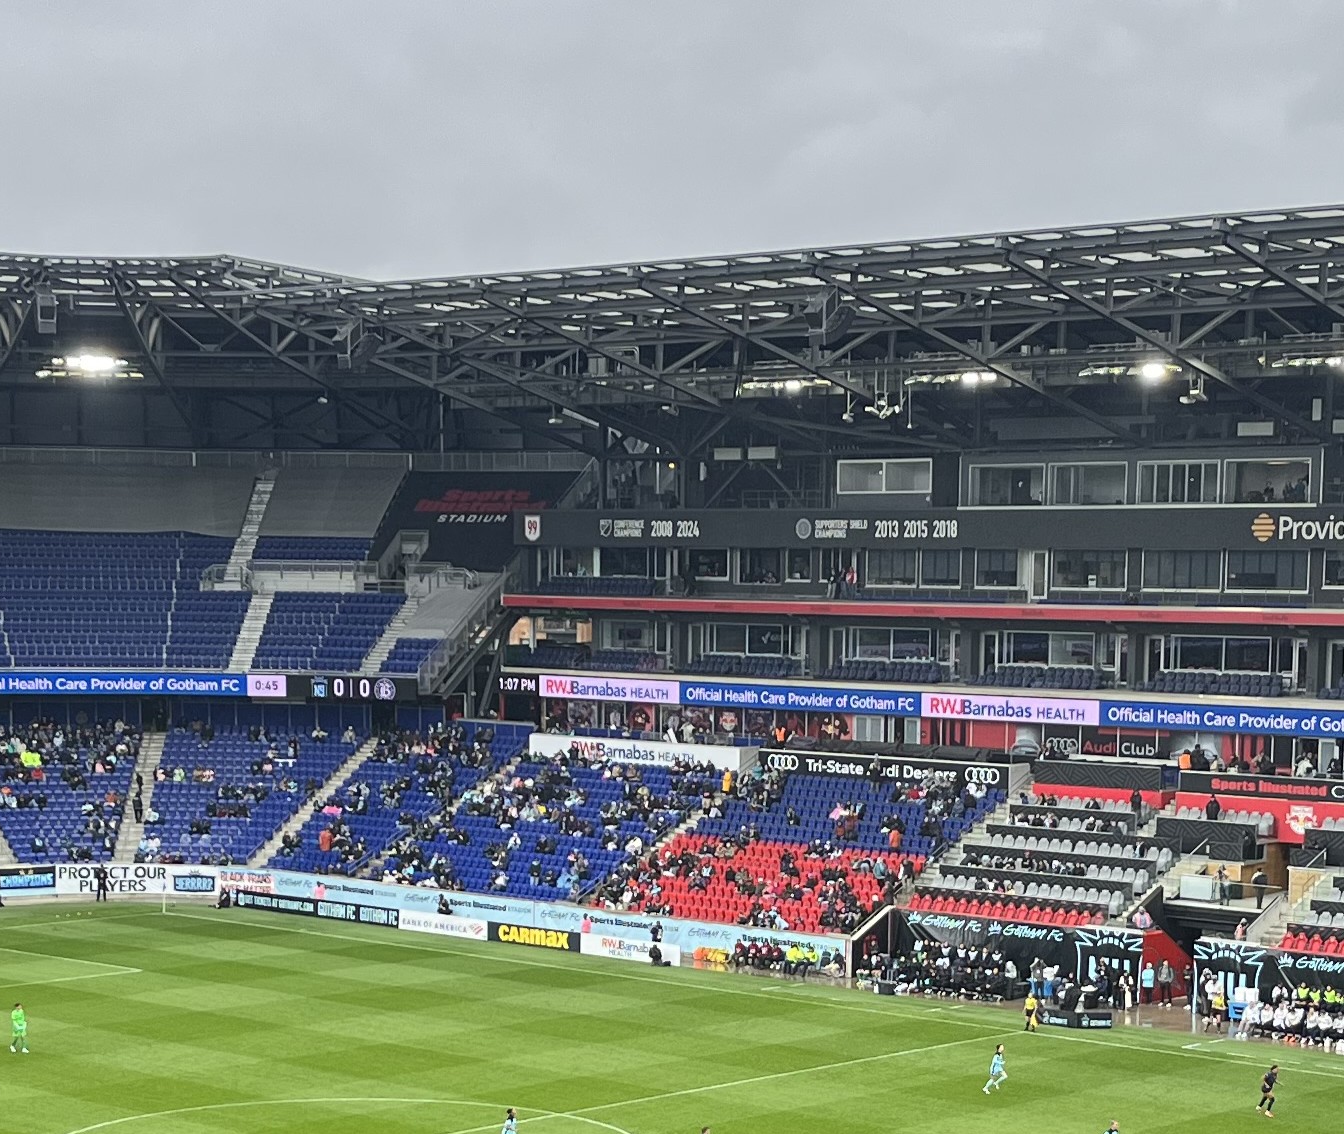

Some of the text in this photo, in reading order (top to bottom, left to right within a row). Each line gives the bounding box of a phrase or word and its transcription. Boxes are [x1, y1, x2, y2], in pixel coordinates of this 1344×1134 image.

[437, 514, 507, 523] STADIUM
[650, 520, 700, 538] 2008 2024
[814, 528, 847, 539] CHAMPIONS
[874, 519, 958, 539] 2013 2015 2018
[255, 681, 279, 691] 0:45
[334, 679, 370, 697] 0 0
[499, 678, 536, 692] 1:07 PM
[545, 678, 669, 700] RWJBarnabas HEALTH
[930, 697, 1085, 722] RWJBarnabas HEALTH
[1083, 741, 1155, 756] Audi Club
[805, 759, 864, 776] Tri-State
[1211, 778, 1256, 793] Sports
[1258, 780, 1327, 797] Illustrated
[0, 873, 53, 888] CHAMPIONS
[134, 866, 166, 879] OUR
[318, 901, 345, 918] GOTHAM
[346, 906, 356, 920] FC
[359, 907, 398, 925] GOTHAM FC
[402, 918, 422, 927] BANK
[435, 922, 467, 933] AMERICA
[922, 914, 982, 932] GOTHAM FC
[1296, 955, 1344, 974] GOTHAM
